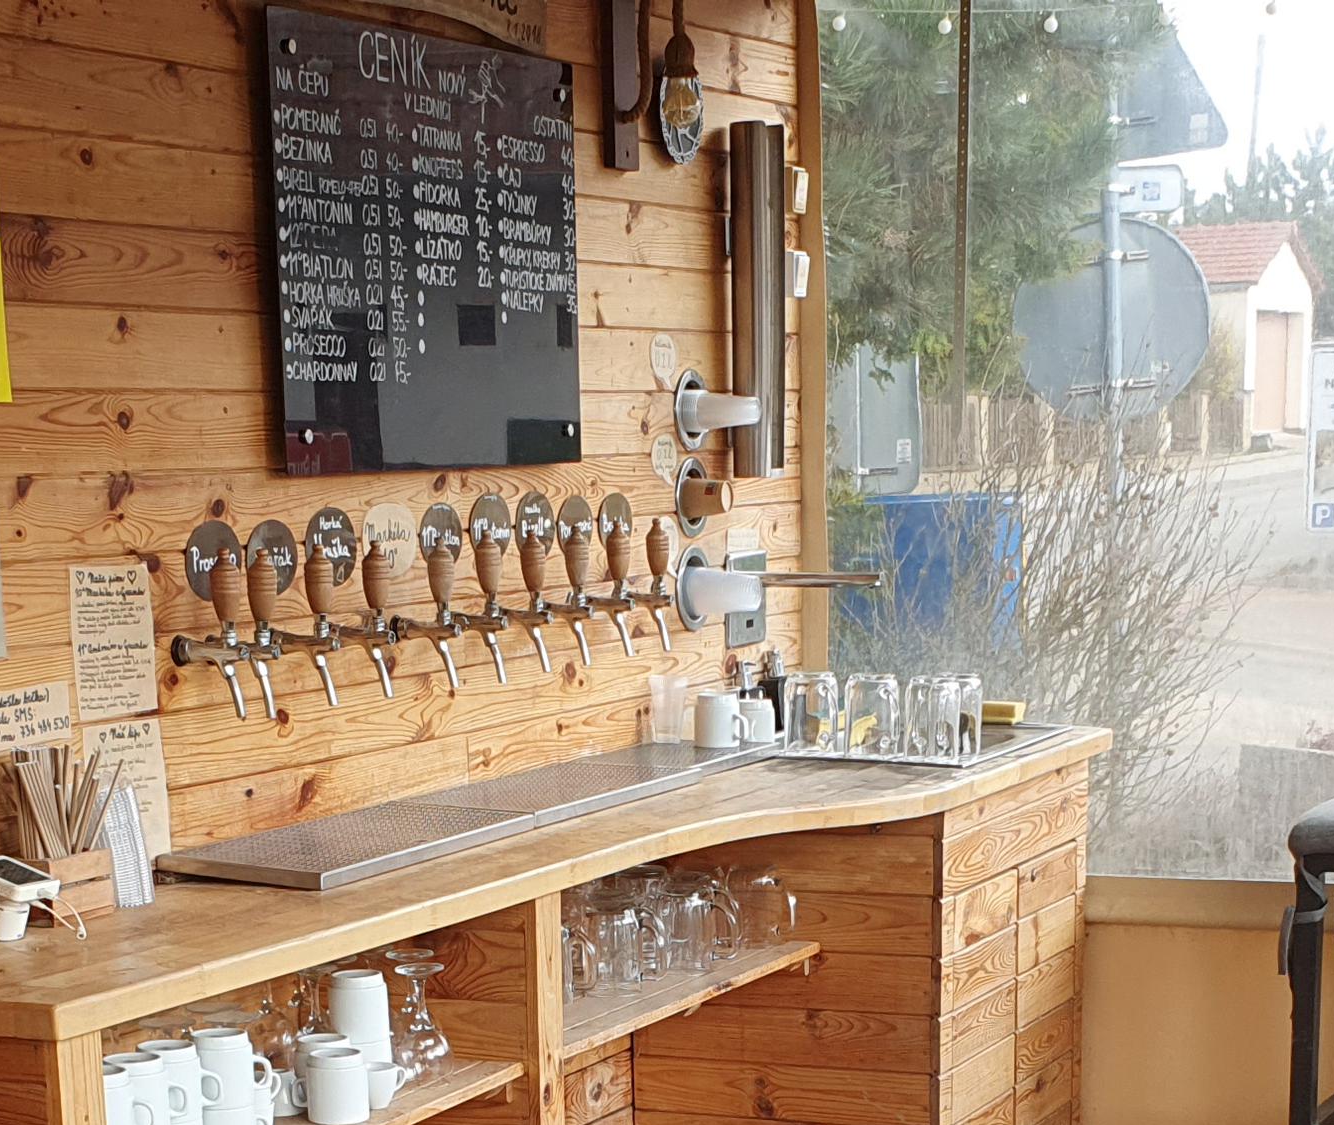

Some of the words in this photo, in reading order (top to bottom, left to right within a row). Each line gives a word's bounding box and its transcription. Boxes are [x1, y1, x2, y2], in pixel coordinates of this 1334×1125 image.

[358, 31, 431, 90] CENÍK
[438, 65, 466, 97] NOVÝ
[275, 66, 294, 91] NA
[298, 63, 329, 97] ČEPU
[404, 92, 411, 110] V
[280, 103, 341, 136] POMERANČ
[533, 114, 573, 142] OSTATNÍ
[417, 124, 462, 152] TATRANKA
[501, 135, 546, 163] ESPRESSO
[282, 166, 316, 193] BIRELL
[502, 162, 522, 188] ČAJ
[501, 189, 538, 217] TYČINKY
[418, 208, 470, 236] HAMBURGER
[420, 233, 462, 261] LÍZÁTKO
[422, 263, 457, 287] RÁJEC
[288, 277, 325, 305] HORKÁ
[326, 280, 361, 309] HRUŠKA
[291, 305, 335, 330] SVAŘÁK
[292, 332, 346, 357] PROSECCO
[292, 361, 357, 383] CHARDONNAY
[319, 515, 344, 531] Horká
[53, 715, 70, 731] 530
